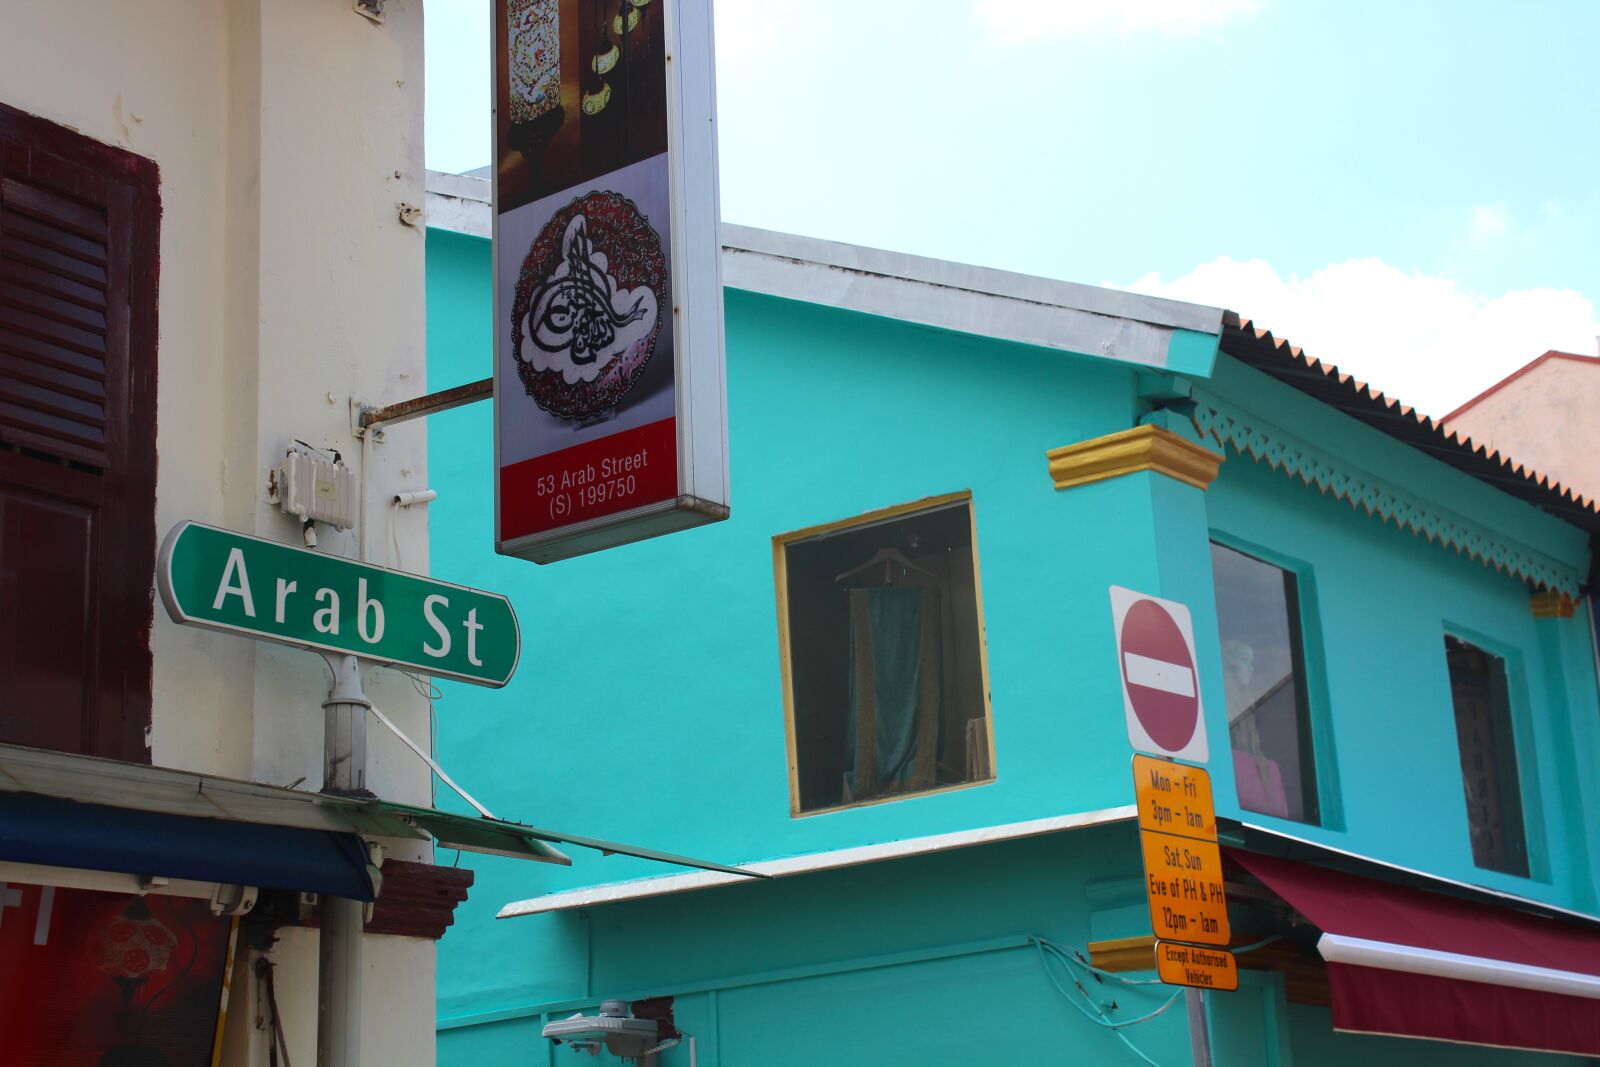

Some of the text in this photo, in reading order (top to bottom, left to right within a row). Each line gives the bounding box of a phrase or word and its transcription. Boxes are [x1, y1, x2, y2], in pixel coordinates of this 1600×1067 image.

[537, 448, 648, 496] 53 Arab Street
[549, 474, 636, 521] (S) 199750
[212, 547, 484, 667] Arab St
[1150, 768, 1171, 793] Mon
[1183, 775, 1197, 798] Fri
[1151, 799, 1172, 827] 3pm
[1184, 805, 1203, 829] 1am
[1184, 848, 1202, 872] Sun
[1149, 874, 1224, 904] Eve of PH & PH
[1162, 906, 1188, 934] 12pm
[1199, 911, 1219, 934] 1am
[1165, 945, 1228, 969] Except Authorised
[1184, 967, 1213, 985] Vehicles
